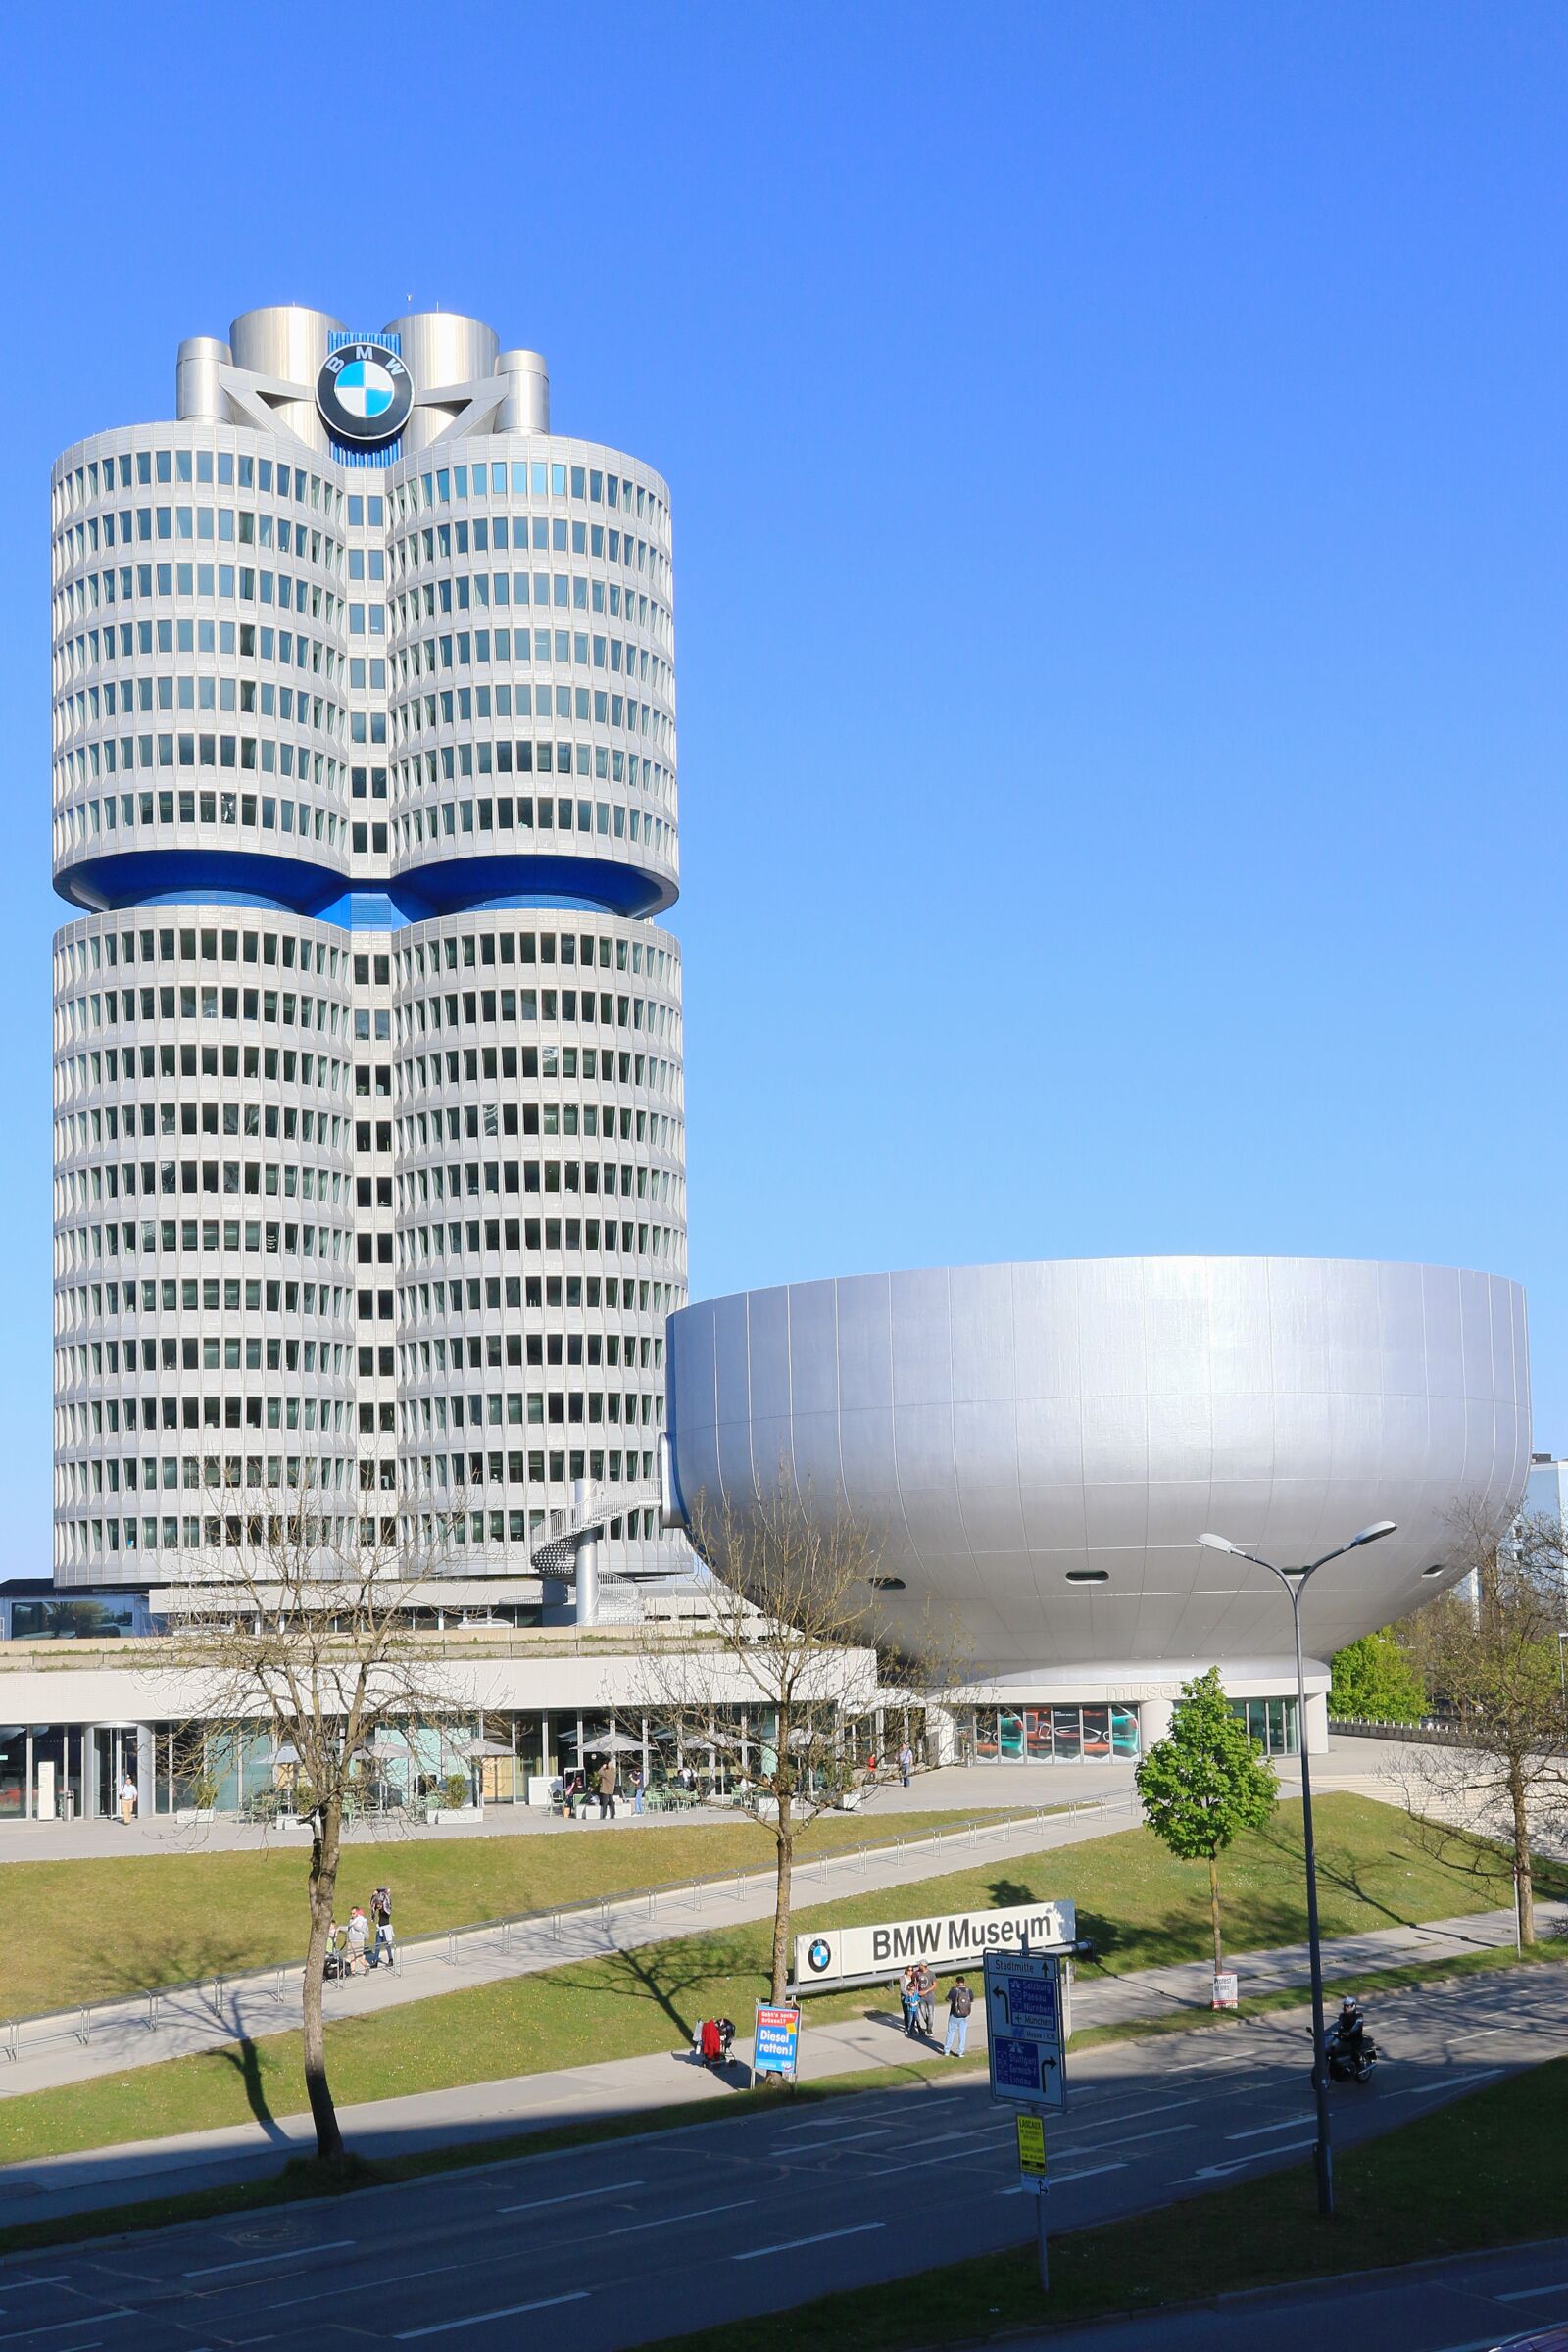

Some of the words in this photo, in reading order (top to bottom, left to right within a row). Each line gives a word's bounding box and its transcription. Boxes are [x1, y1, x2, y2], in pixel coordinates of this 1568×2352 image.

[325, 346, 405, 376] BMW
[1106, 1683, 1186, 1701] museu
[872, 1922, 942, 1961] BMW
[948, 1915, 1051, 1951] Museum
[995, 1959, 1035, 1974] Stadtmitte
[1022, 1981, 1052, 1994] Salzburg
[1023, 1991, 1048, 2003] Passau
[1023, 2002, 1054, 2016] Nürnberg
[1024, 2015, 1053, 2027] München
[760, 2029, 790, 2043] Diesel
[760, 2043, 793, 2057] retten!
[1009, 2075, 1032, 2086] Lindau
